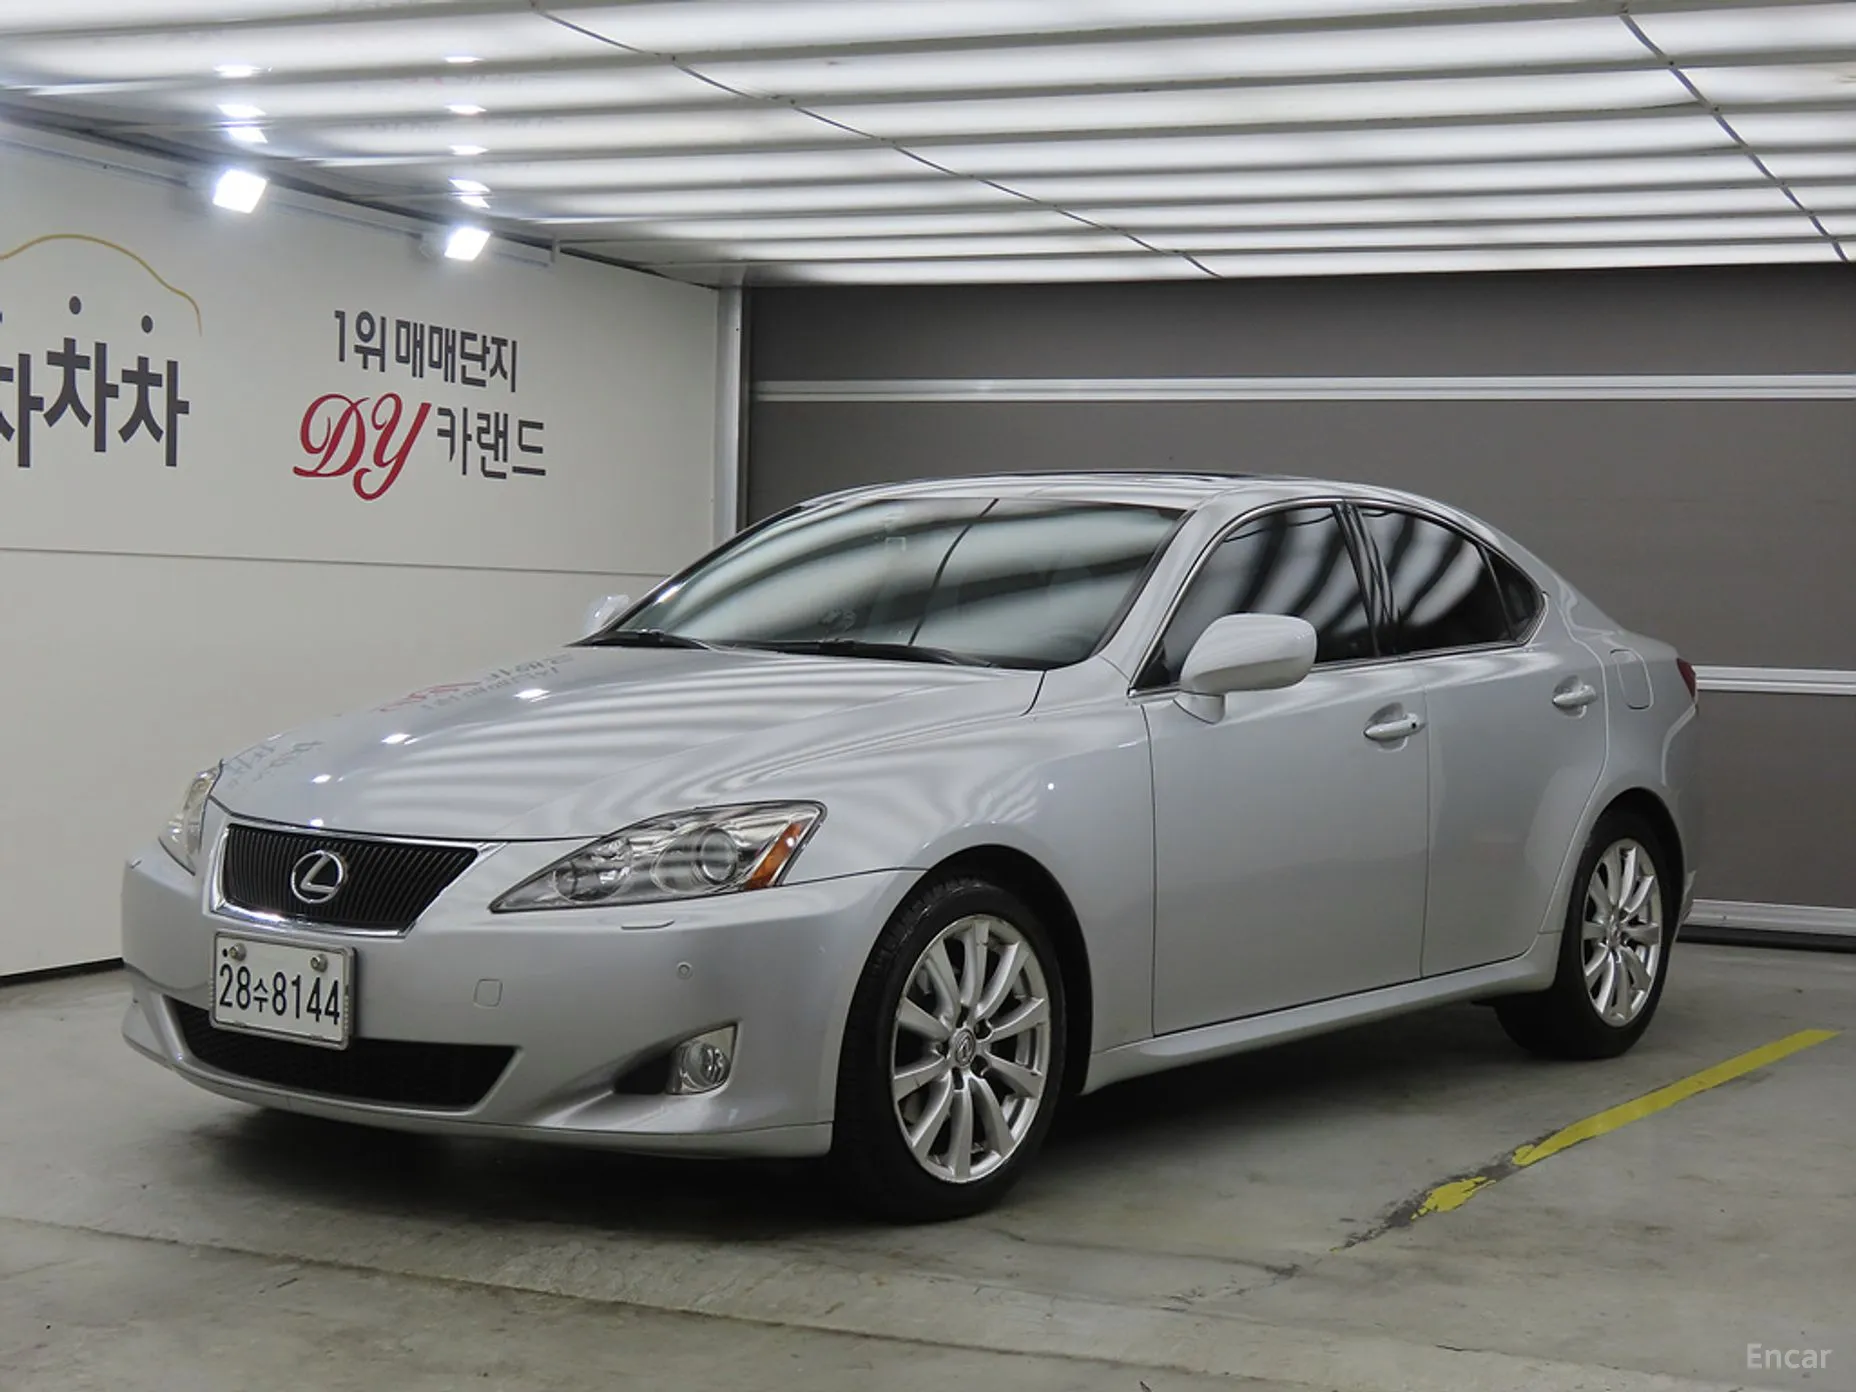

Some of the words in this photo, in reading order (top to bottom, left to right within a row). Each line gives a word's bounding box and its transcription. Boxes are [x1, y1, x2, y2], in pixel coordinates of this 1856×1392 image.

[334, 310, 387, 373] 1위
[395, 319, 518, 393] 매매단지
[292, 392, 433, 501] DY
[437, 407, 547, 480] 카랜드
[219, 963, 341, 1026] 28수8144
